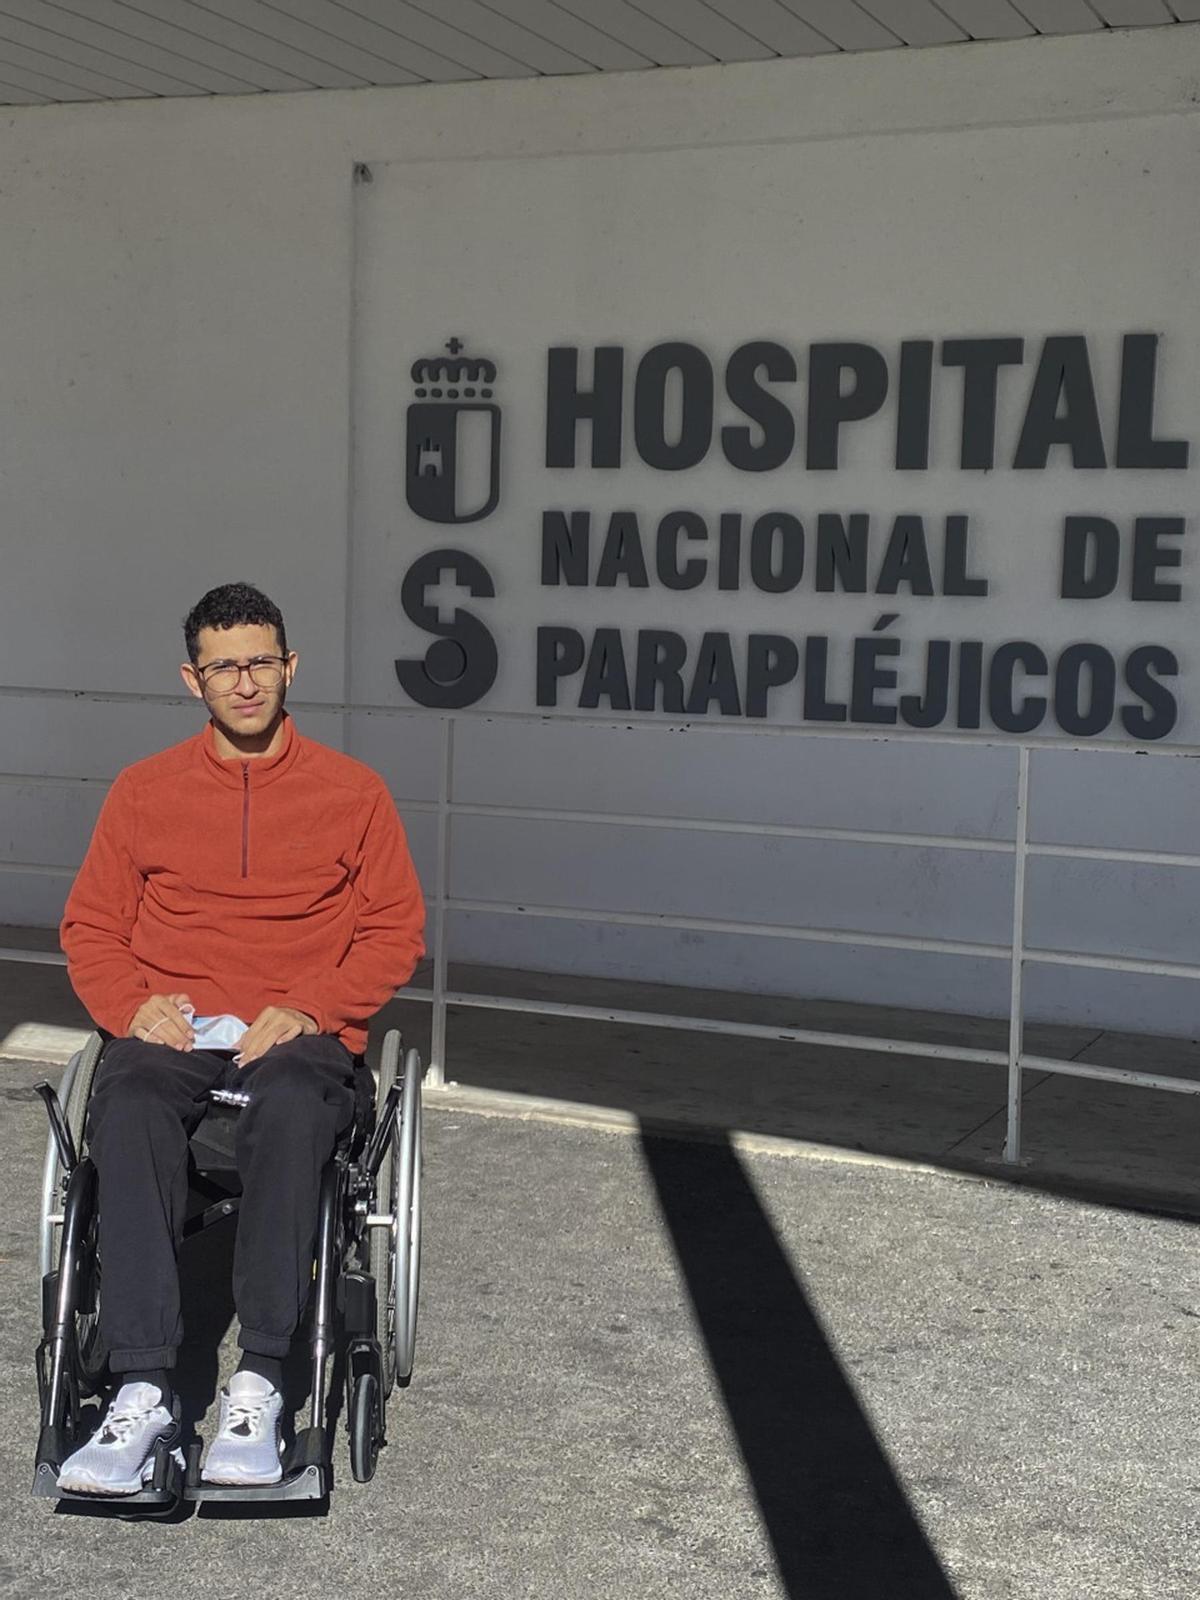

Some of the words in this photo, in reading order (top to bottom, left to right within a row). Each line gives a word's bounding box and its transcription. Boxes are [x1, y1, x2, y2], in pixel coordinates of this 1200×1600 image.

[545, 334, 1190, 471] HOSPITAL
[540, 510, 989, 597] NACIONAL
[1061, 515, 1186, 603] DE
[536, 613, 1179, 741] PARAPLÉJICOS
